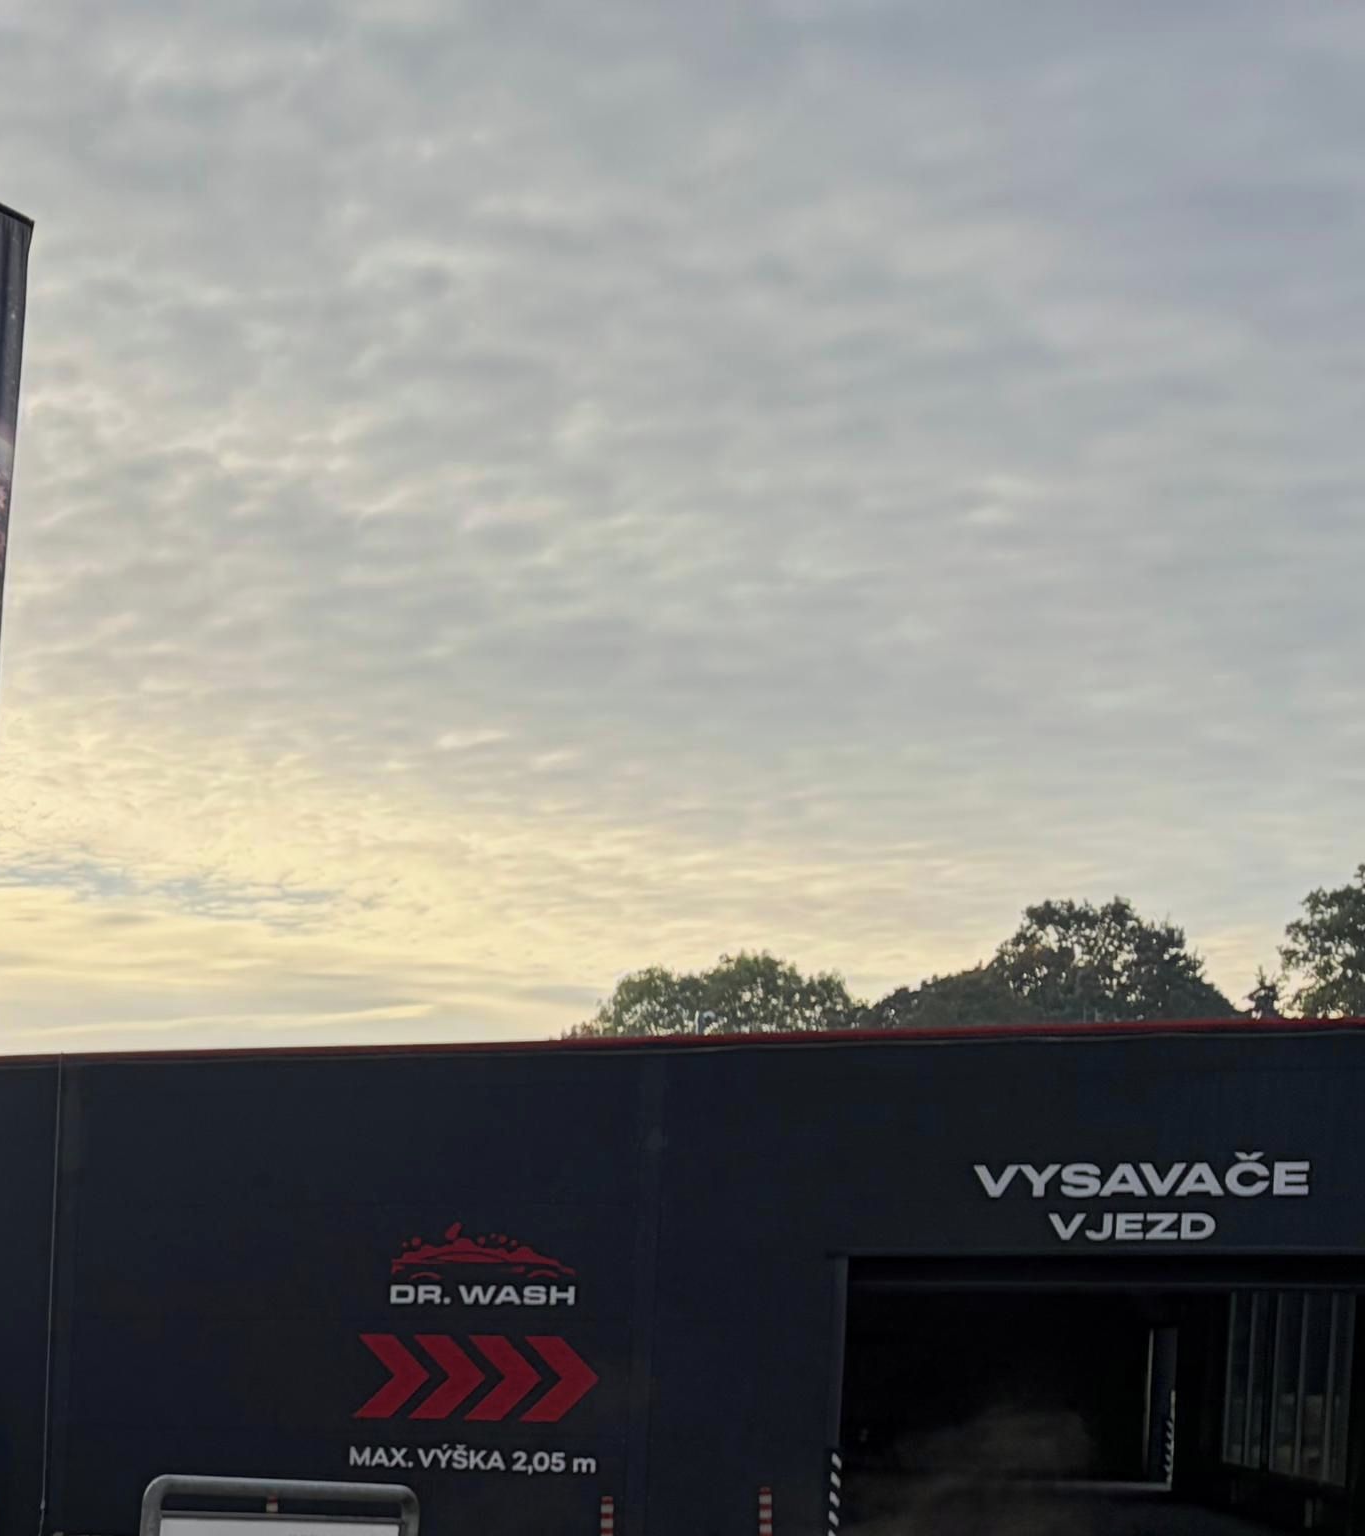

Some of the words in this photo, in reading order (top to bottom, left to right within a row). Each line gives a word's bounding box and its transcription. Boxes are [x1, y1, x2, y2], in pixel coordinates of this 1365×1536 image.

[974, 1151, 1310, 1198] VYSAVAČE
[1048, 1212, 1217, 1241] VJEZD
[390, 1284, 451, 1305] DR.
[458, 1284, 576, 1306] WASH
[349, 1446, 413, 1468] MAX.
[417, 1444, 505, 1471] VÝŠKA
[512, 1451, 566, 1475] 2,05
[572, 1455, 596, 1473] m
